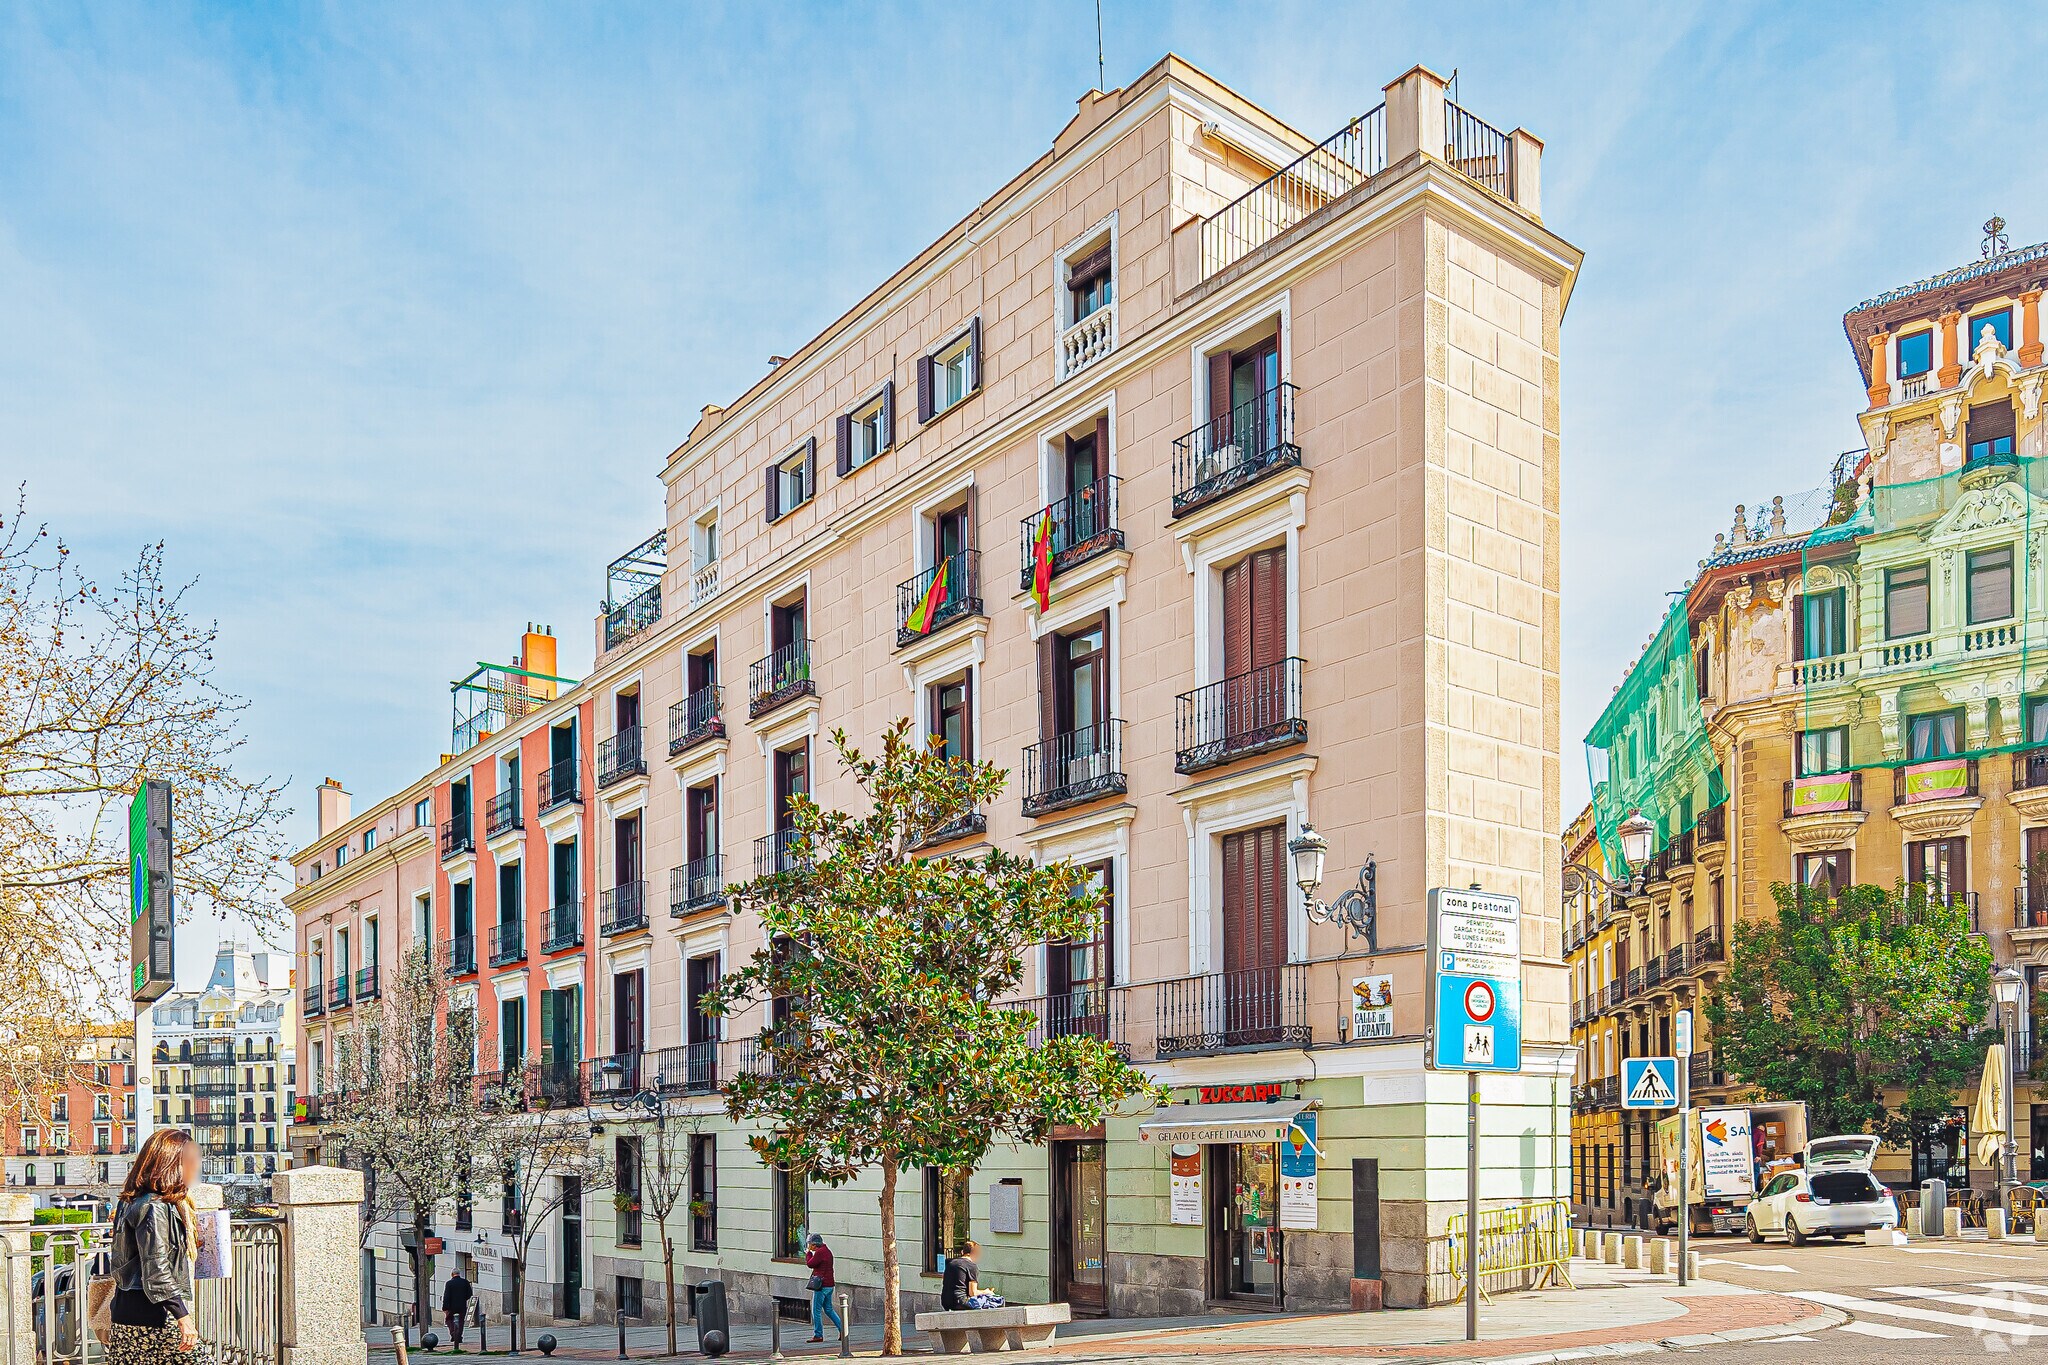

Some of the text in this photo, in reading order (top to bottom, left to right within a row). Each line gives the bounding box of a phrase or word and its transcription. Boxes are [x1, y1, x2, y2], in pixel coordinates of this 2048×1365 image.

[1446, 898, 1512, 913] zona peatonal
[1355, 1012, 1386, 1024] CALLE DE
[1357, 1023, 1391, 1037] LEPANTO
[1158, 1129, 1266, 1141] GELATO E CAFFÉ ITALIANO
